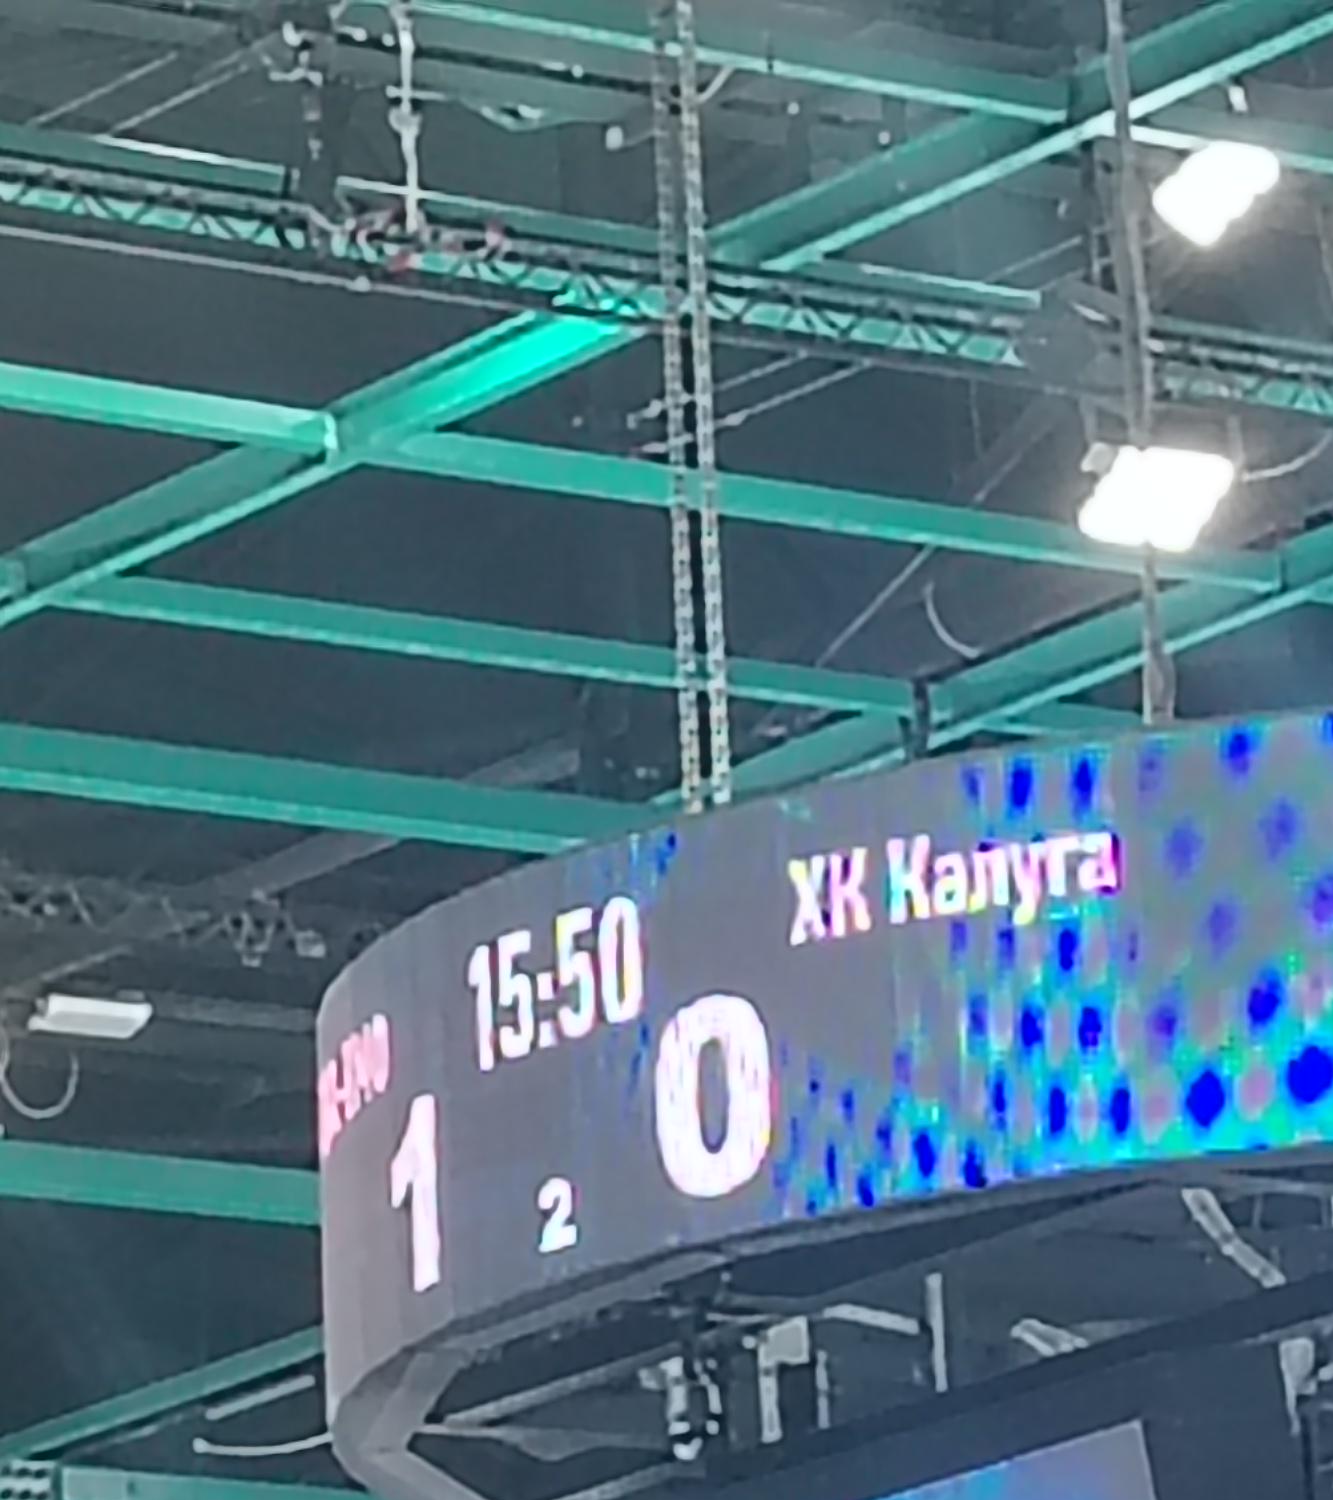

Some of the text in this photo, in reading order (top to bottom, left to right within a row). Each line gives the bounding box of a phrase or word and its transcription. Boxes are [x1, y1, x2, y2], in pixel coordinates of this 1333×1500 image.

[788, 833, 1122, 946] ХК Калуга
[467, 896, 646, 1071] 15:50
[654, 994, 774, 1198] 0
[390, 1093, 443, 1292] 1
[536, 1176, 579, 1252] 2
